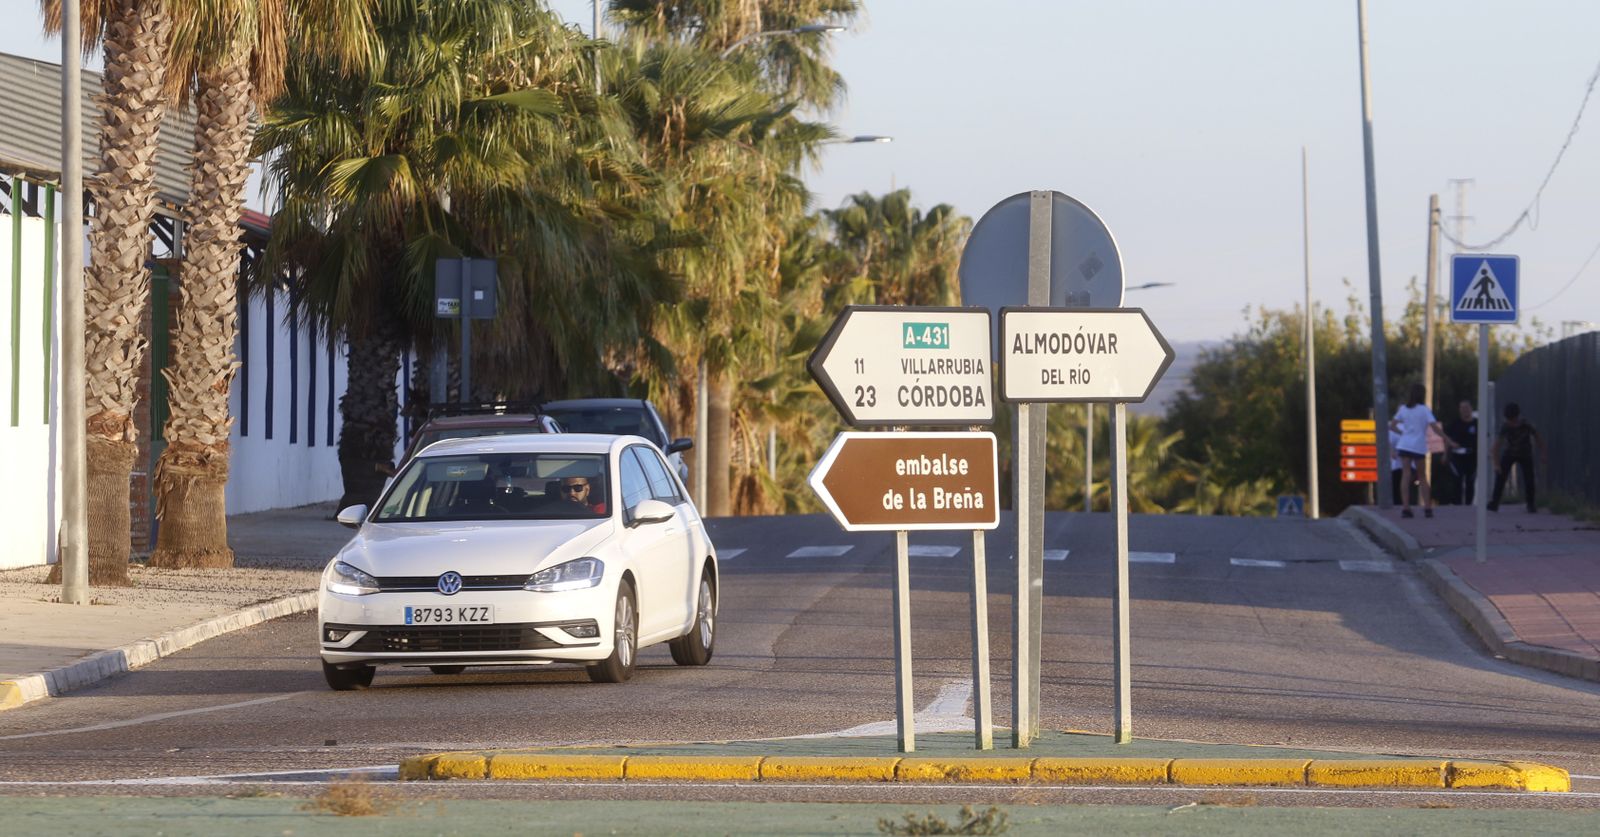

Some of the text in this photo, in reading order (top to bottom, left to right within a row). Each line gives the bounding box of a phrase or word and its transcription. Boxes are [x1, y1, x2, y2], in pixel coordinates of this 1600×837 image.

[905, 325, 948, 346] A-431
[1013, 326, 1118, 355] ALMODÓVAR
[854, 358, 984, 375] 11 VILLARRUBIA
[1041, 364, 1090, 384] DEL RÍO
[855, 379, 985, 407] 23 CÓRDOBA
[896, 453, 968, 475] embalse
[883, 487, 984, 510] de la Breña
[414, 609, 452, 622] 8793
[459, 607, 489, 621] KZZ
